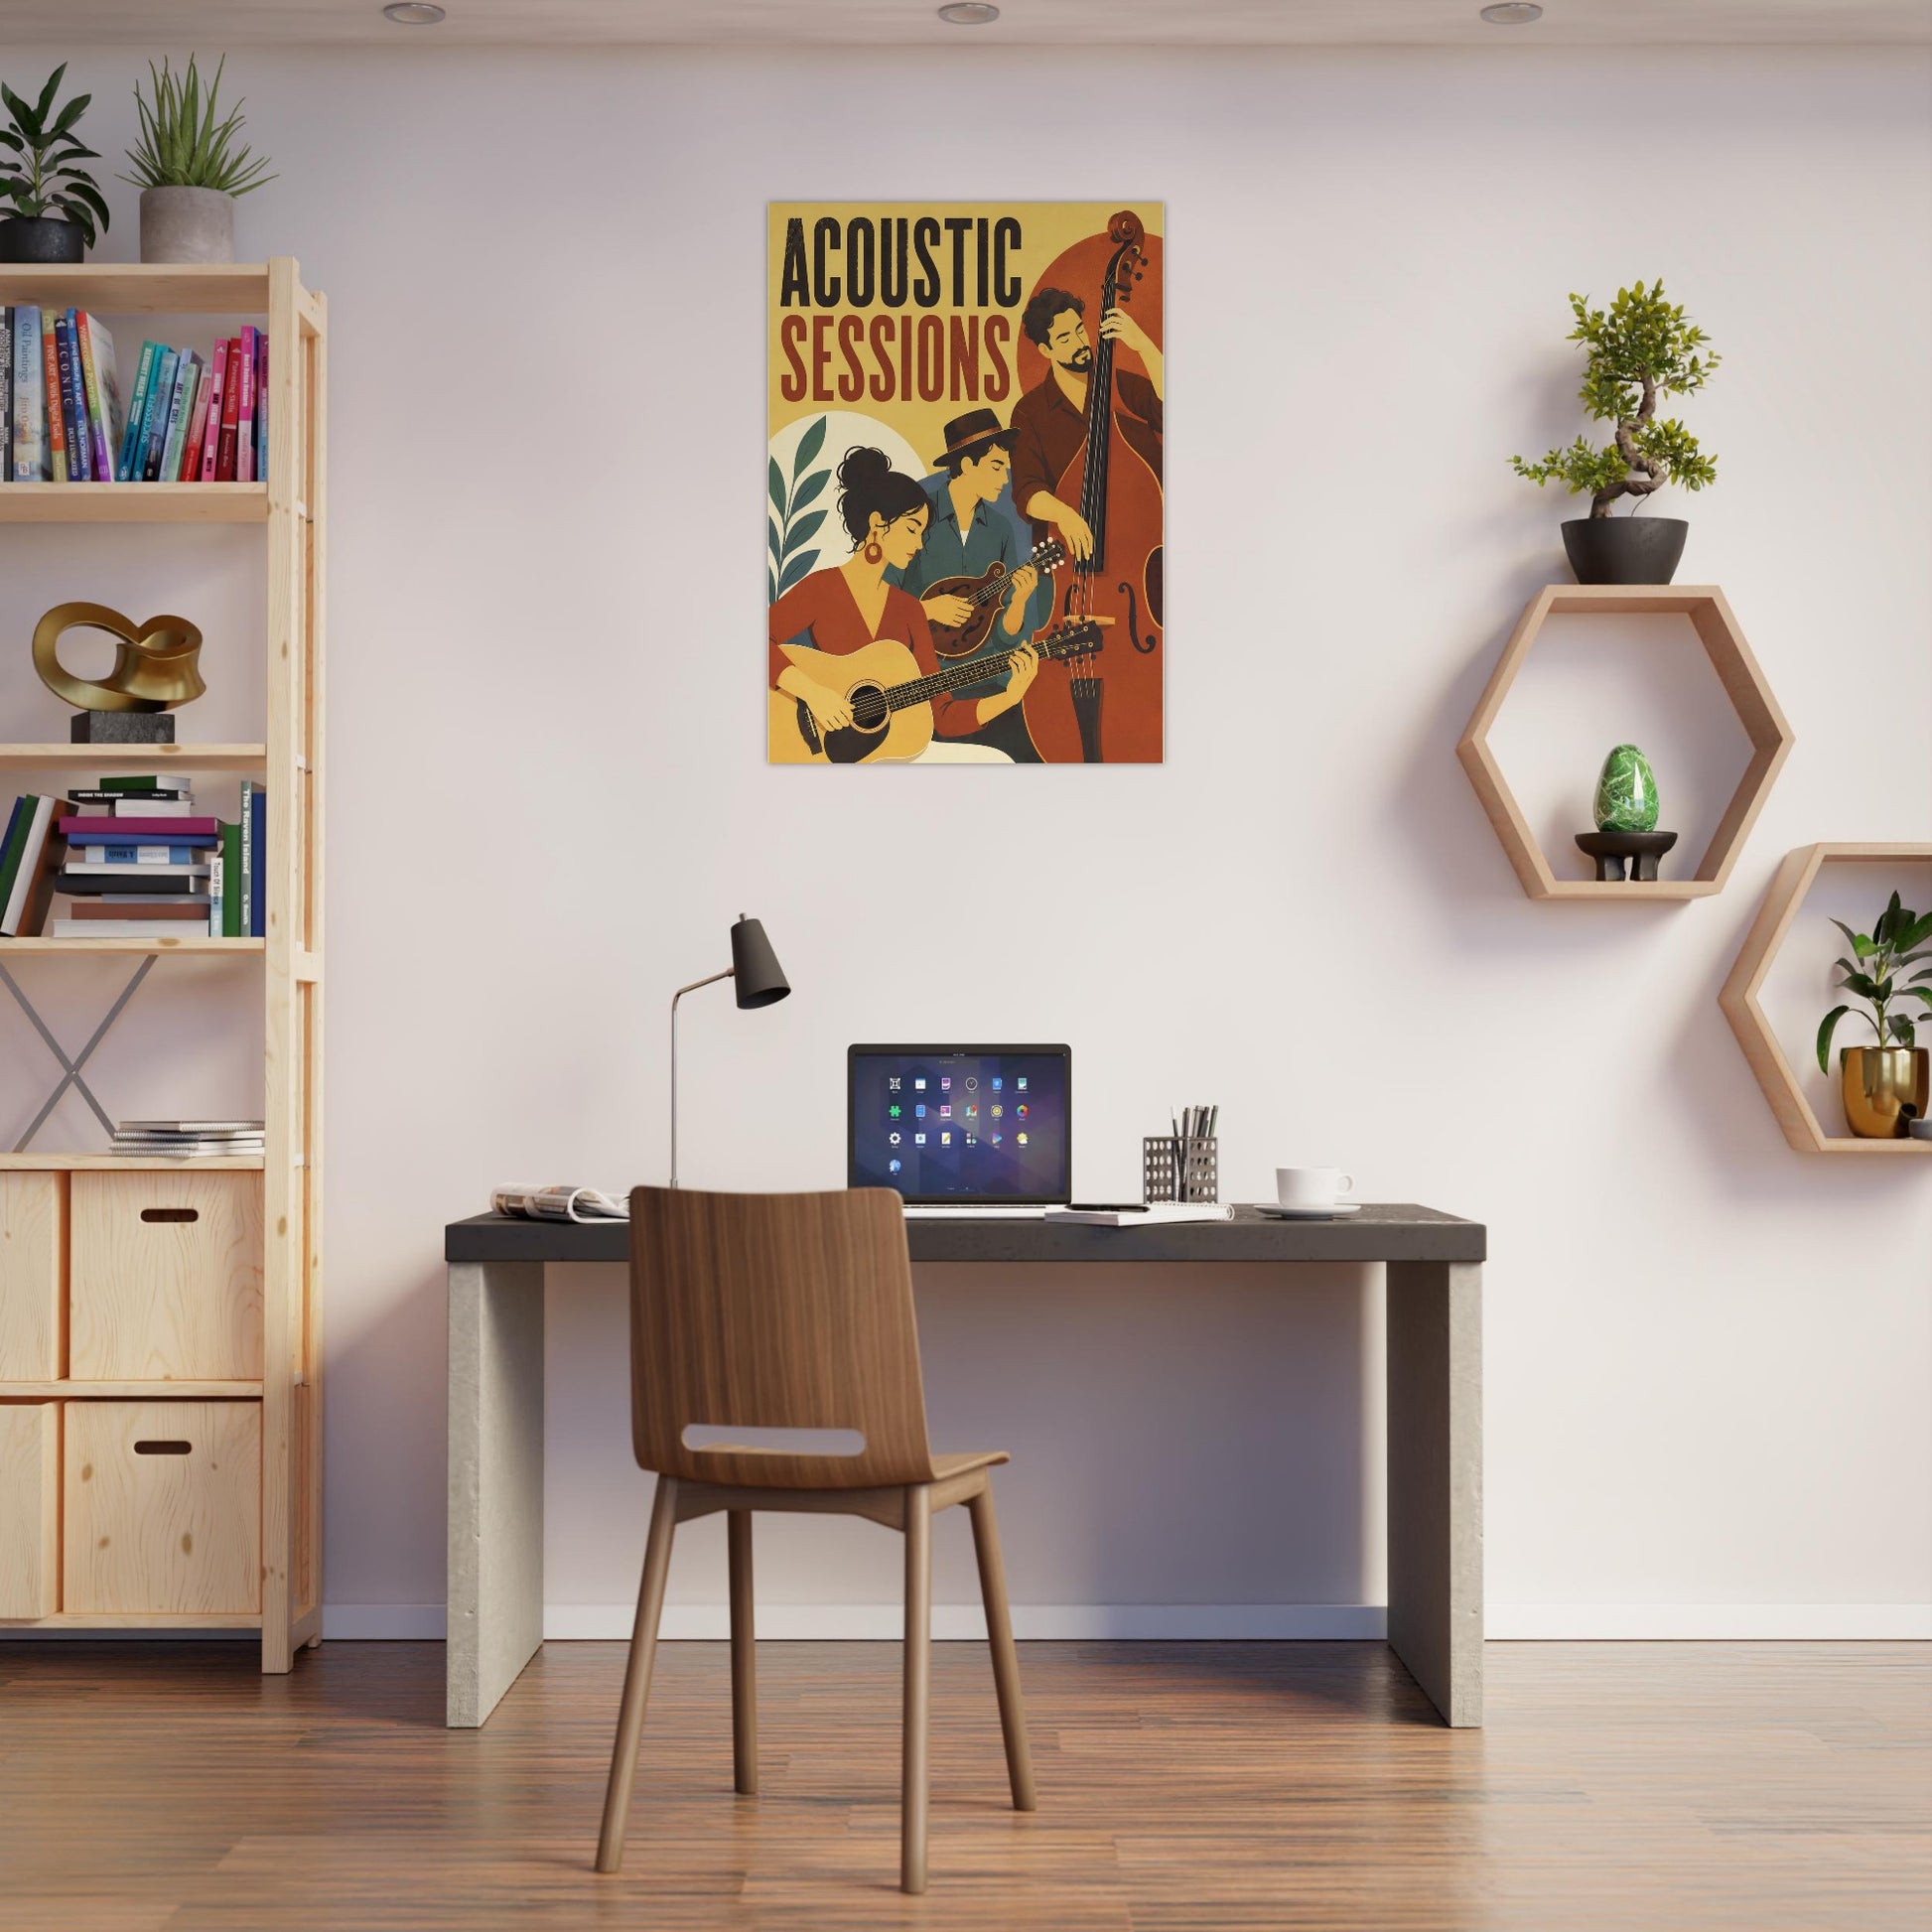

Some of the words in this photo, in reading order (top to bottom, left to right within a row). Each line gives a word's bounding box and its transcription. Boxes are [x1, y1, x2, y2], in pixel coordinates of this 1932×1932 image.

[780, 216, 1022, 308] ACOUSTIC
[23, 323, 32, 337] Oil
[18, 340, 32, 383] Paintings
[59, 342, 72, 405] ICONIC
[72, 357, 81, 381] Beauty
[78, 325, 91, 370] Watercolor
[87, 373, 97, 408] Portraits
[780, 315, 1011, 403] SESSIONS
[50, 382, 59, 399] With
[228, 361, 238, 394] Parenting
[50, 400, 61, 421] Digital
[53, 422, 62, 439] Tools
[79, 437, 88, 469] NORMAN
